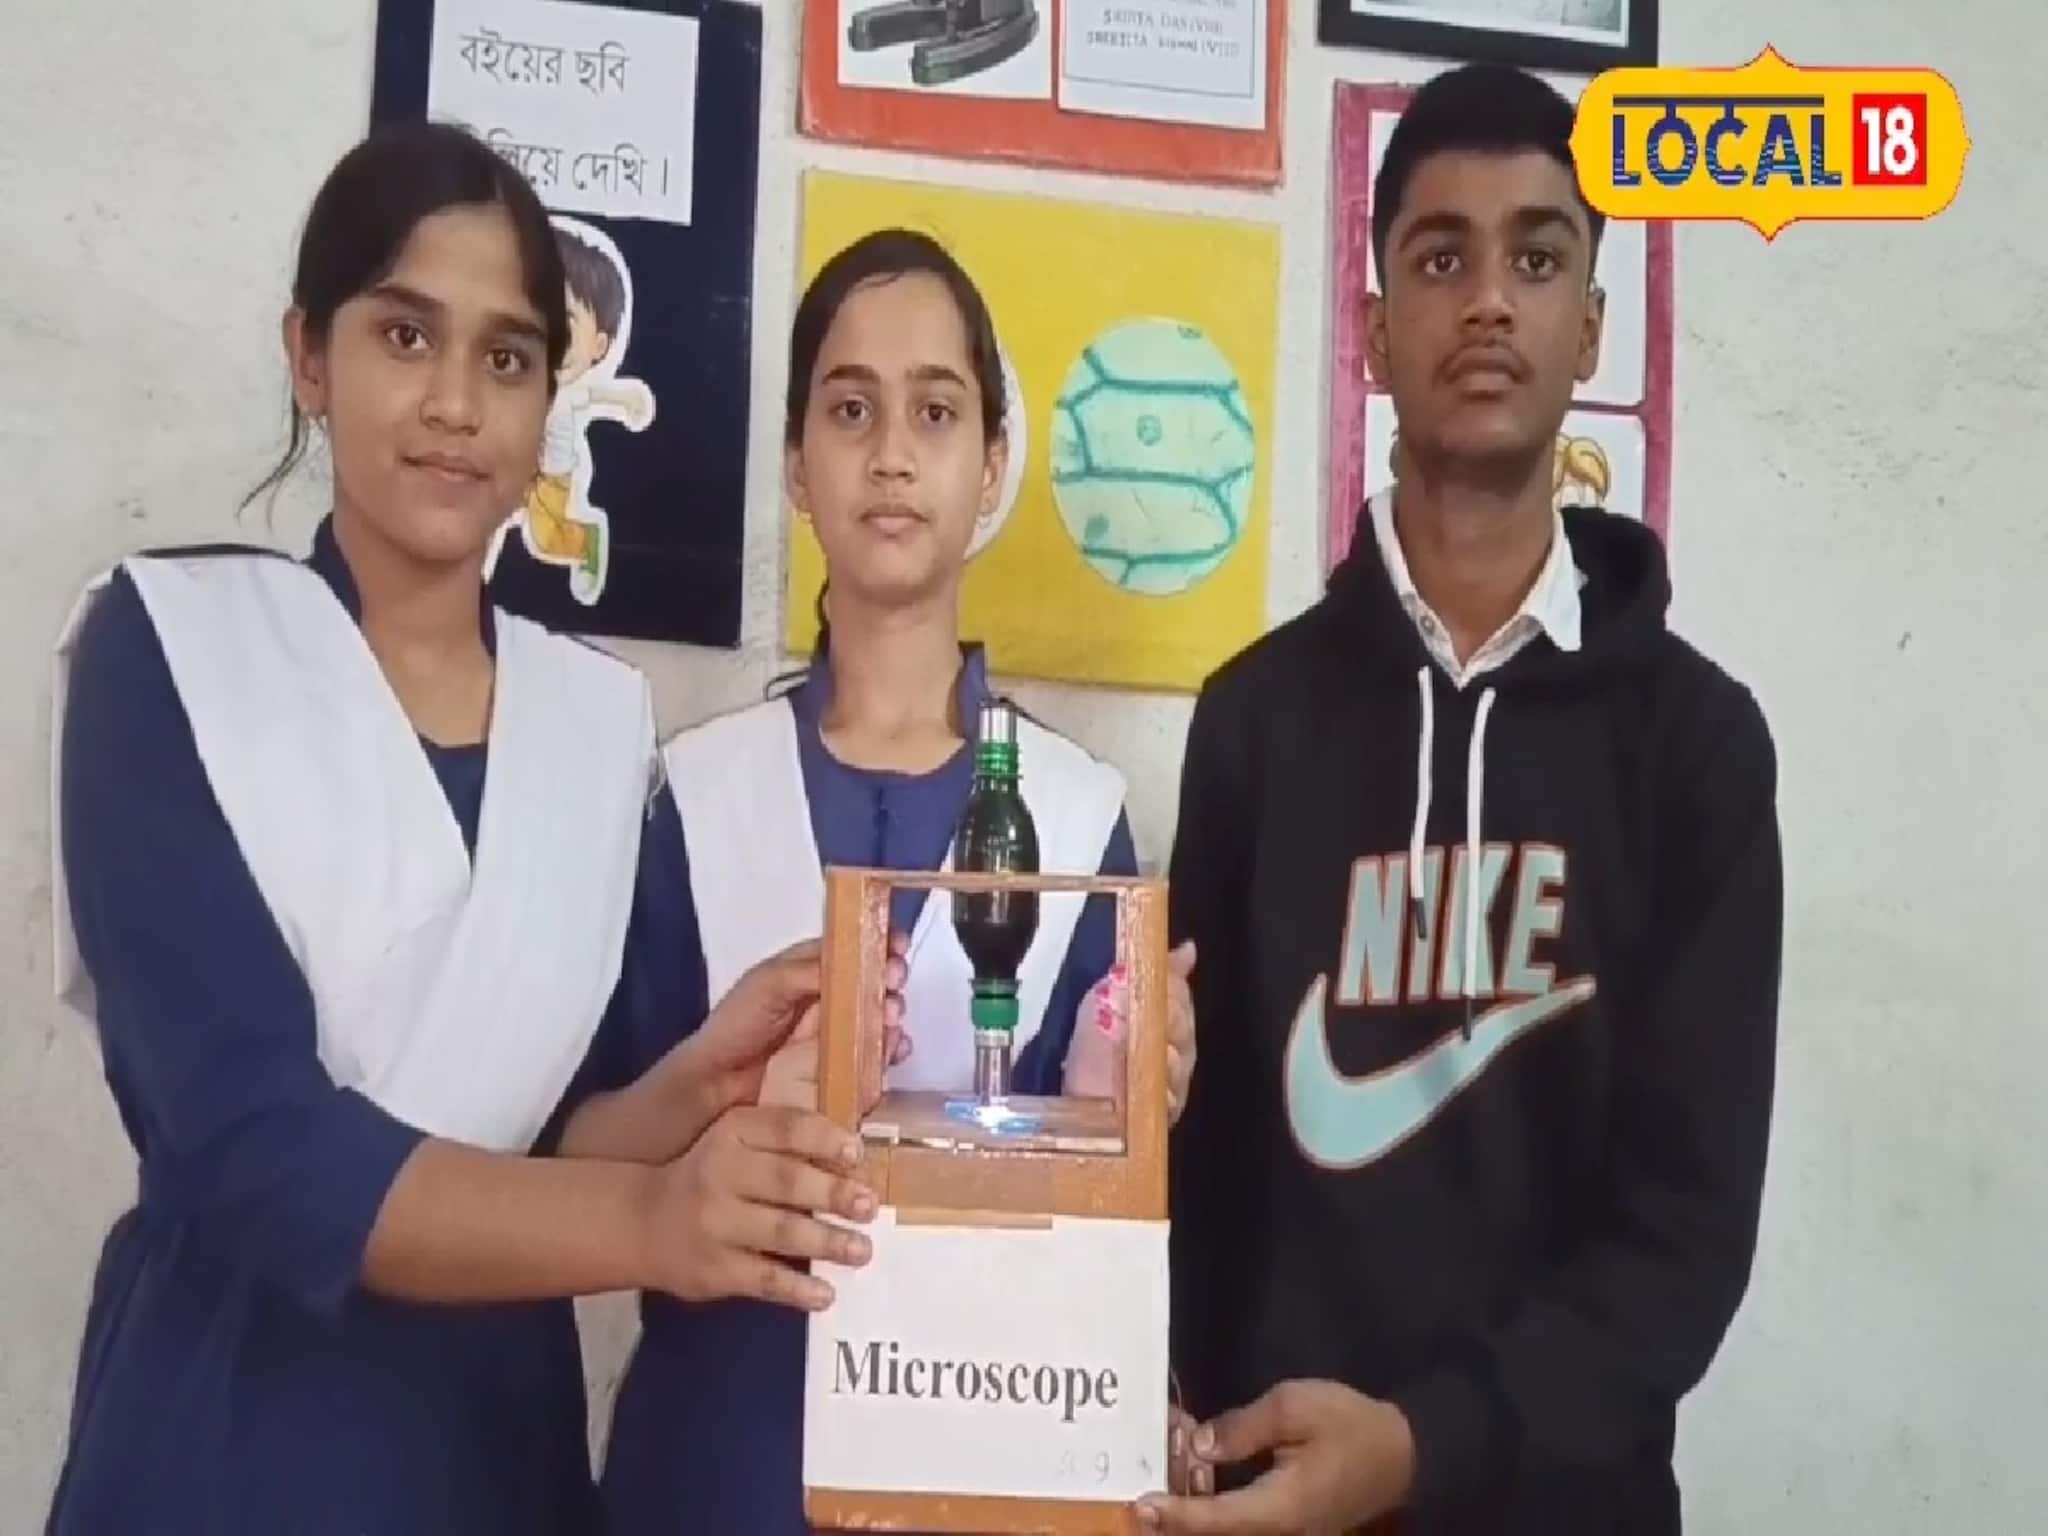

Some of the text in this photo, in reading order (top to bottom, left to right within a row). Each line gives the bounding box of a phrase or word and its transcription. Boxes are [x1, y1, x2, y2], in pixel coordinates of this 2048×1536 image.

[458, 26, 630, 95] বইয়ের ছবি
[572, 143, 648, 195] দেখি
[1335, 841, 1566, 1005] NIKE
[832, 1340, 1119, 1423] Microscope
